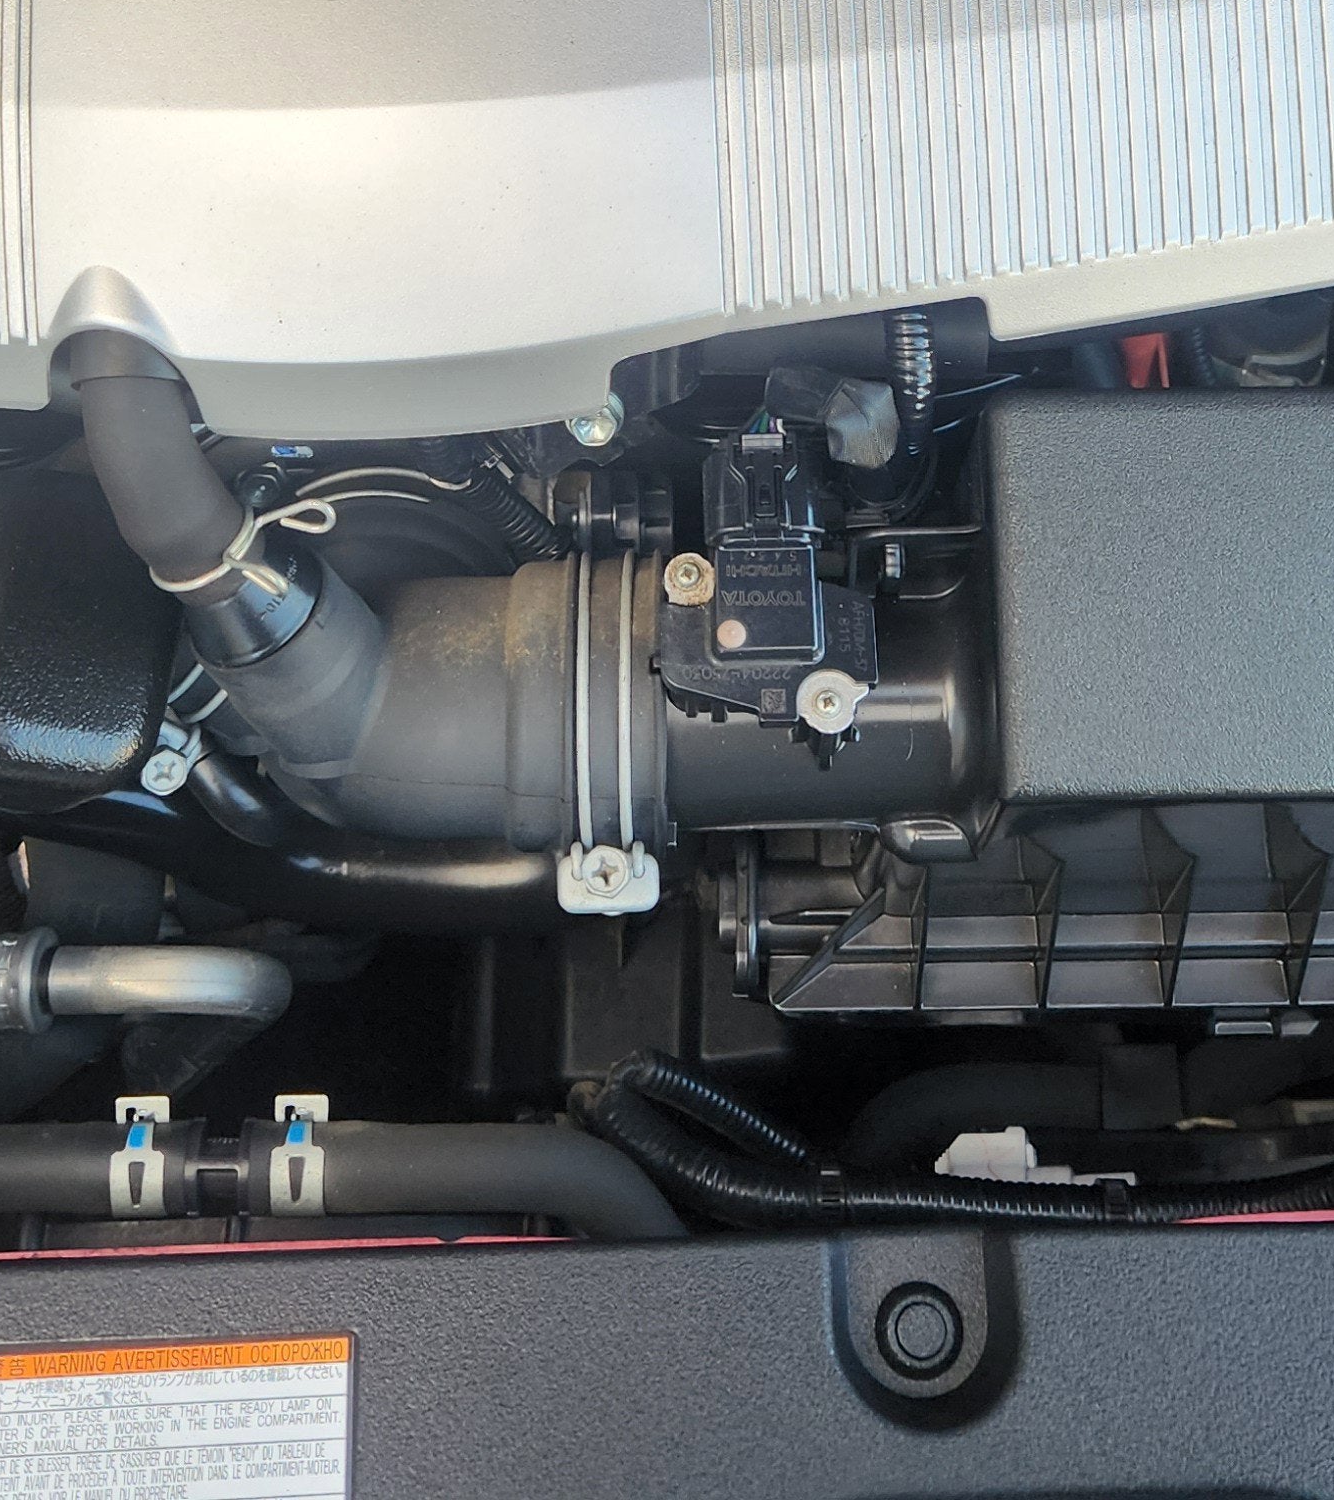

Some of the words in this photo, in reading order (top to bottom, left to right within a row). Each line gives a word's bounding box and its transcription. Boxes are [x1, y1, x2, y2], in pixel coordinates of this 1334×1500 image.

[726, 564, 801, 578] HITACHI
[720, 590, 806, 606] TOYOTA
[32, 1352, 107, 1375] WARNING
[112, 1345, 244, 1371] AVERTISSEMENT
[250, 1339, 343, 1363] ОСТОРОЖНО
[63, 1409, 103, 1424] PLEASE
[109, 1407, 139, 1421] MAKE
[144, 1406, 172, 1419] SURE
[179, 1404, 207, 1418] THAT
[213, 1402, 233, 1416] THE
[239, 1400, 274, 1414] READY
[280, 1398, 310, 1412] LAMP
[316, 1397, 332, 1410] ON
[24, 1426, 35, 1440] IS
[39, 1425, 61, 1439] OFF
[67, 1423, 109, 1437] BEFORE
[114, 1420, 164, 1435] WORKING
[170, 1419, 181, 1432] IN
[186, 1417, 207, 1431] THE
[213, 1415, 251, 1430] ENGINE
[256, 1410, 342, 1427] COMPARTMENT.
[33, 1438, 79, 1453] MANUAL
[85, 1436, 108, 1450] FOR
[113, 1434, 158, 1449] DETAILS.
[8, 1458, 21, 1475] DE
[22, 1457, 34, 1474] SE
[105, 1453, 115, 1470] DE
[163, 1450, 180, 1467] QUE
[182, 1449, 193, 1466] LE
[228, 1446, 259, 1463] "READY"
[261, 1445, 274, 1462] DU
[277, 1443, 312, 1461] TABLEAU
[314, 1442, 325, 1459] DE
[23, 1474, 50, 1491] AVANT
[53, 1473, 65, 1489] DE
[121, 1469, 146, 1486] TOUTE
[150, 1466, 204, 1485] INTERVENTION
[207, 1464, 229, 1482] DANS
[232, 1464, 242, 1480] LE
